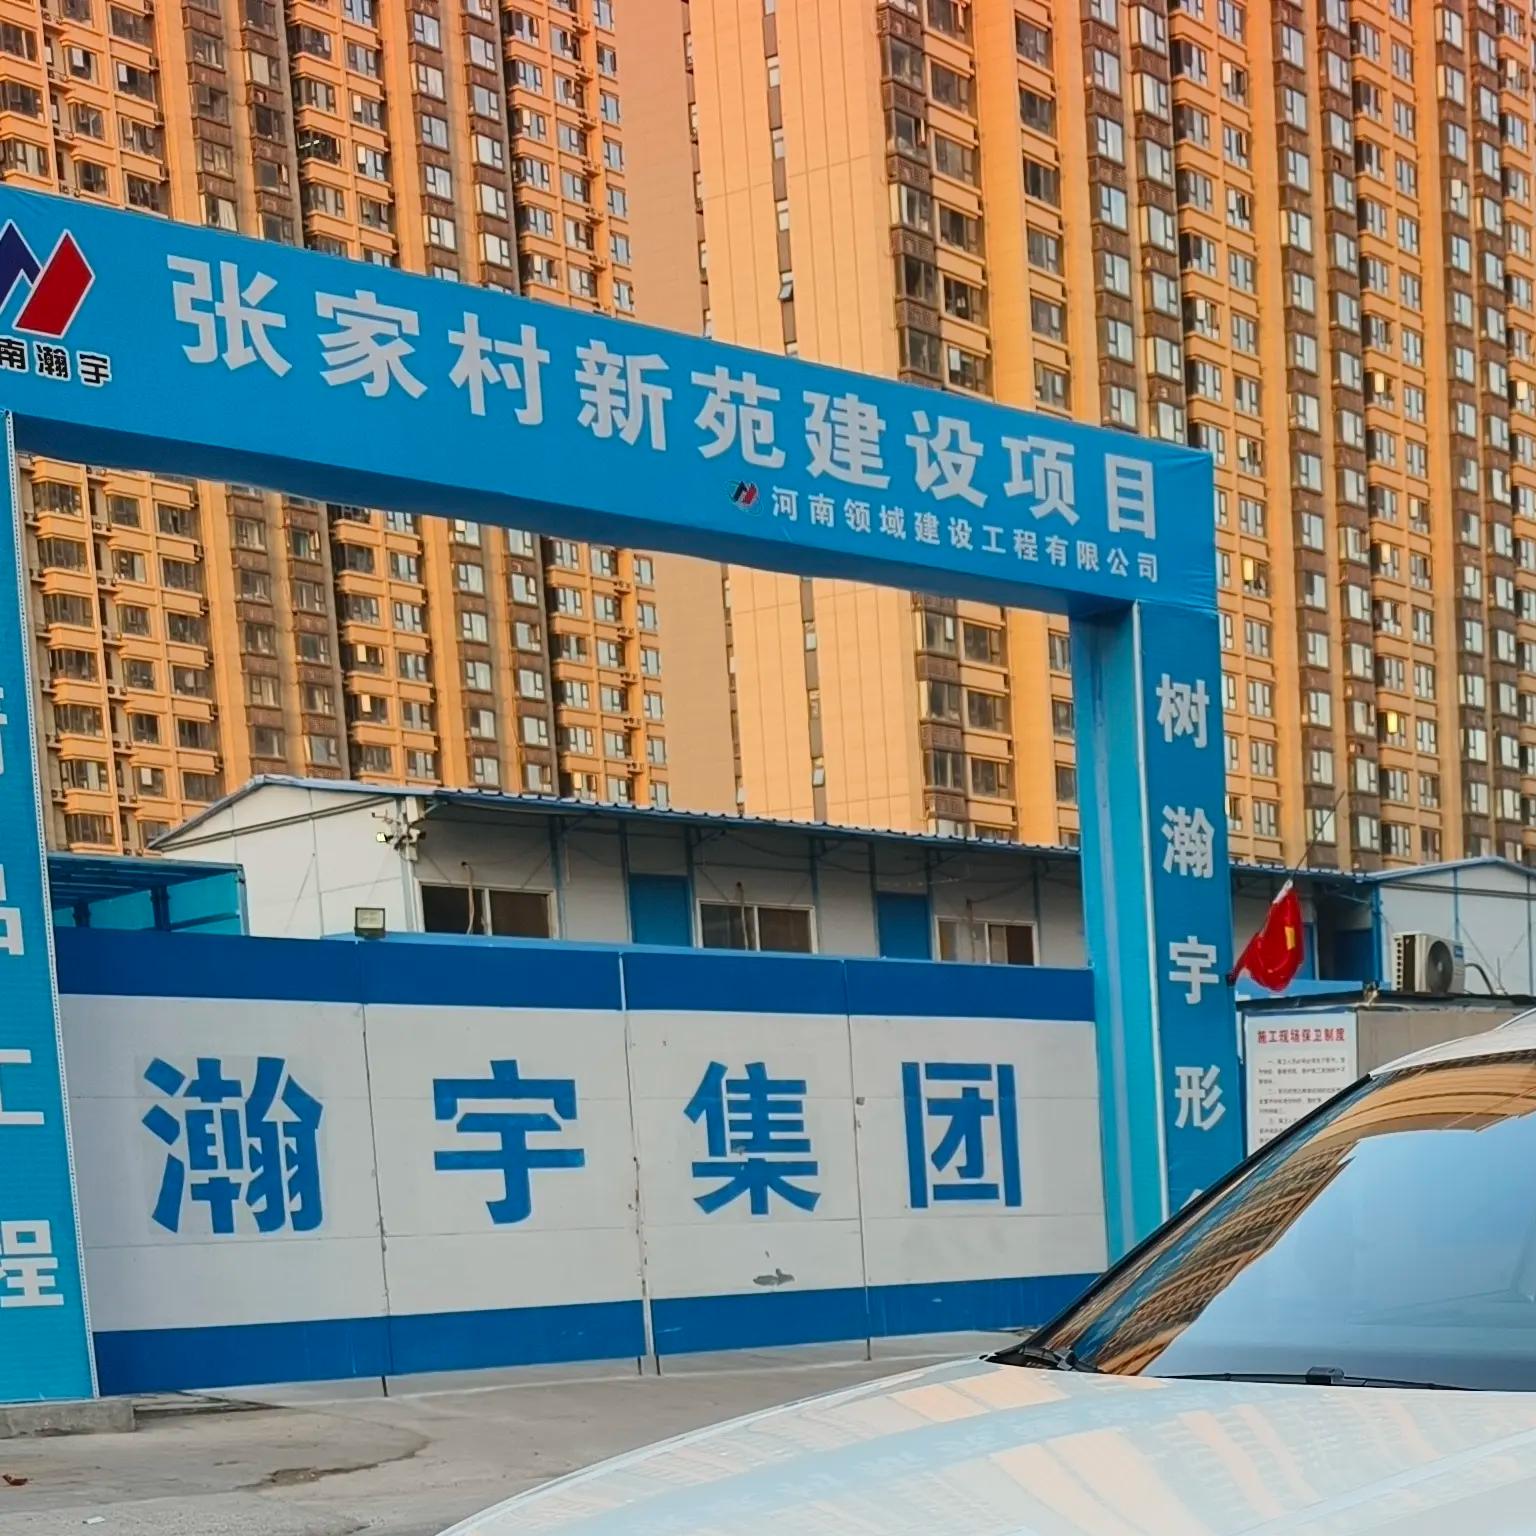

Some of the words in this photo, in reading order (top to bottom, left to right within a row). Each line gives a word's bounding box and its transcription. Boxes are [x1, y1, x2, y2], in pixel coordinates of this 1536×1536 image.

[166, 254, 1158, 540] 张家村新苑建设项目
[771, 485, 1159, 583] 河南领域建设工程有限公司
[1156, 673, 1227, 1209] 树瀚宇形
[141, 1056, 1023, 1234] 瀚宇集团
